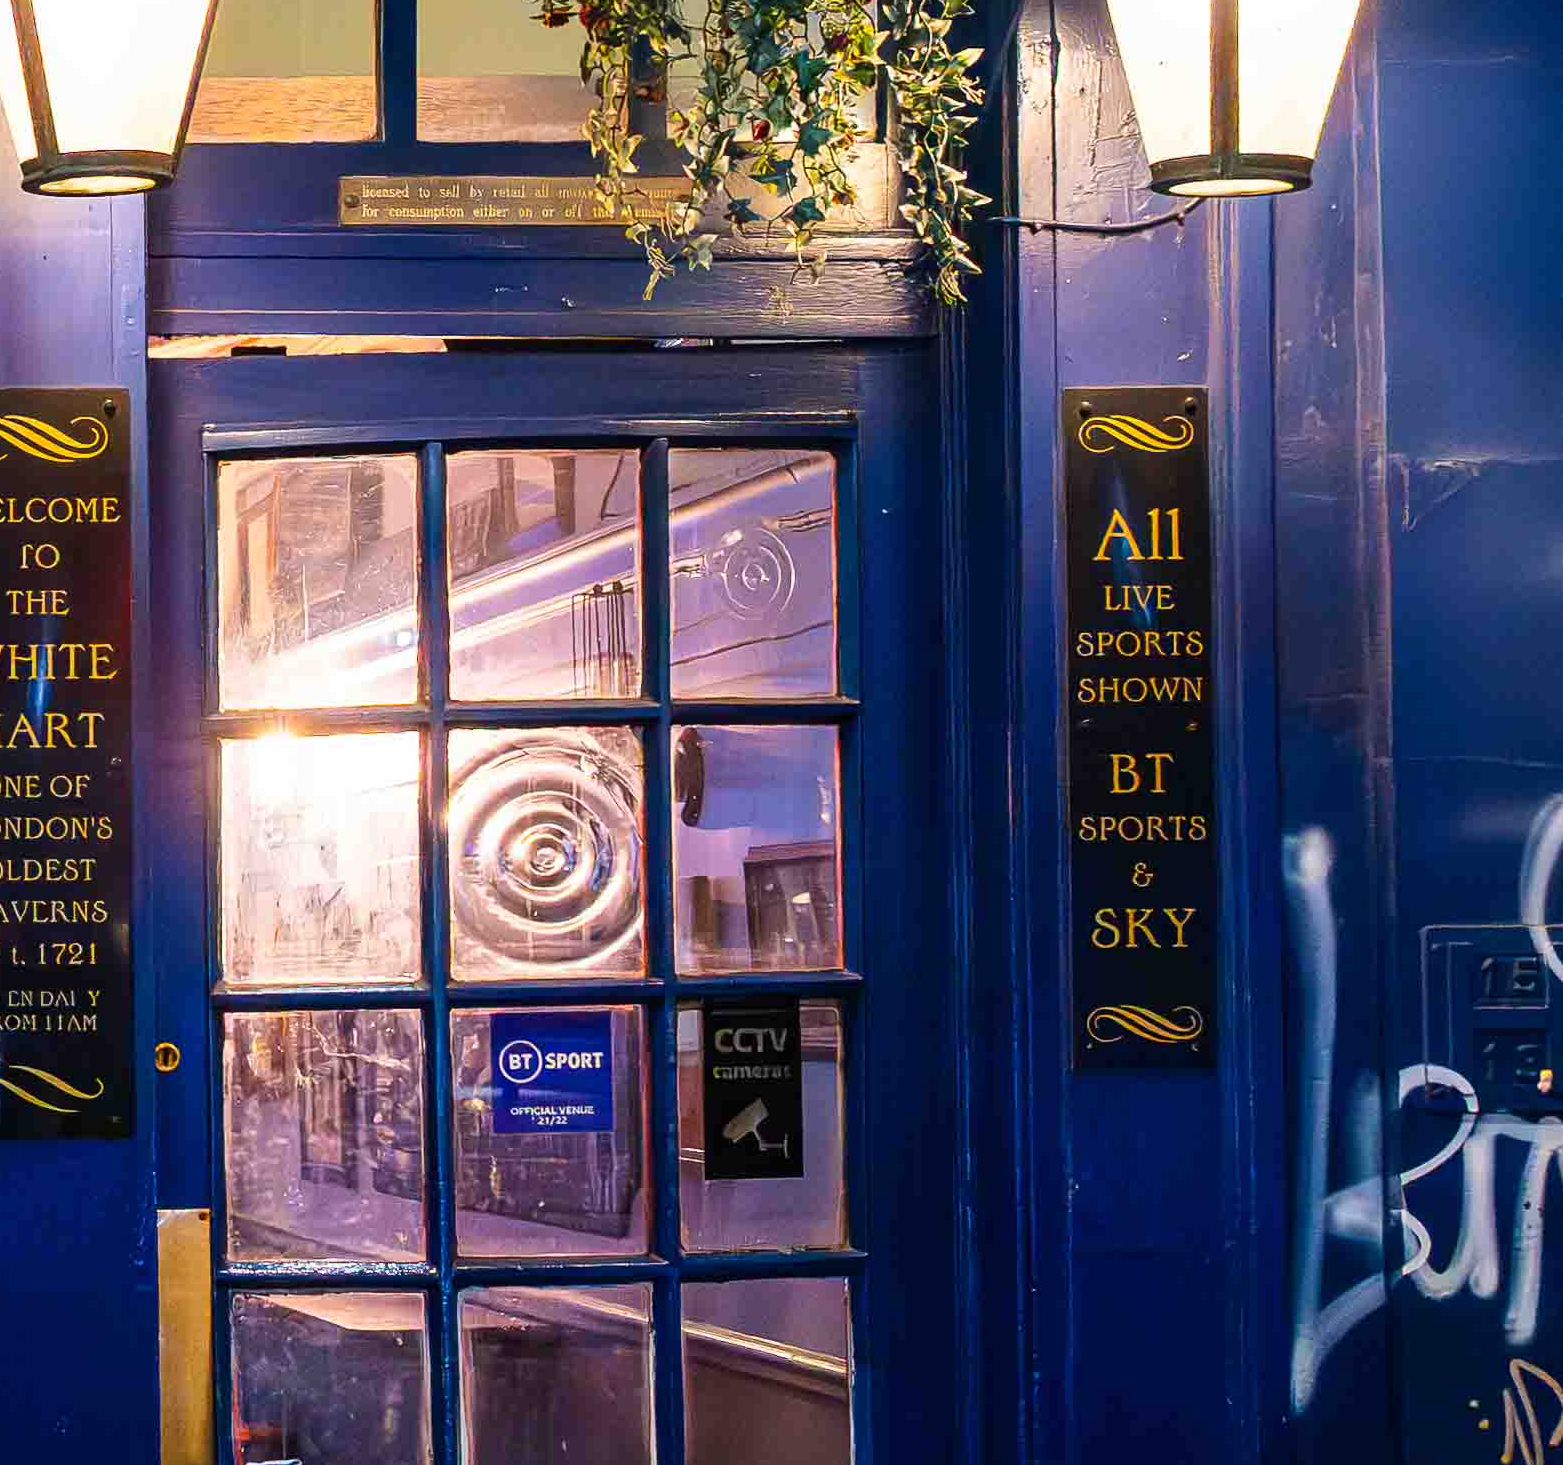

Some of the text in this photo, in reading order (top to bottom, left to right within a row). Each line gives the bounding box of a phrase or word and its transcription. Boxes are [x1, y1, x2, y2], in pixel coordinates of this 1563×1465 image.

[389, 205, 464, 220] consumption
[1092, 507, 1186, 561] All
[5, 590, 70, 616] THE
[1104, 585, 1175, 611] LIVE
[1076, 631, 1204, 657] SPORTS
[1078, 676, 1203, 703] SHOWN
[1109, 752, 1174, 794] BT
[49, 774, 91, 799] OF
[1078, 816, 1207, 841] SPORTS
[1132, 862, 1154, 887] &
[1090, 907, 1197, 949] SKY
[38, 942, 96, 965] 1721
[40, 989, 101, 1007] DAIY
[714, 1027, 789, 1054] CCTV
[508, 1052, 604, 1070] BT SPORT
[509, 1105, 596, 1116] OFFICIAL VENUE
[535, 1115, 570, 1127] 21/22
